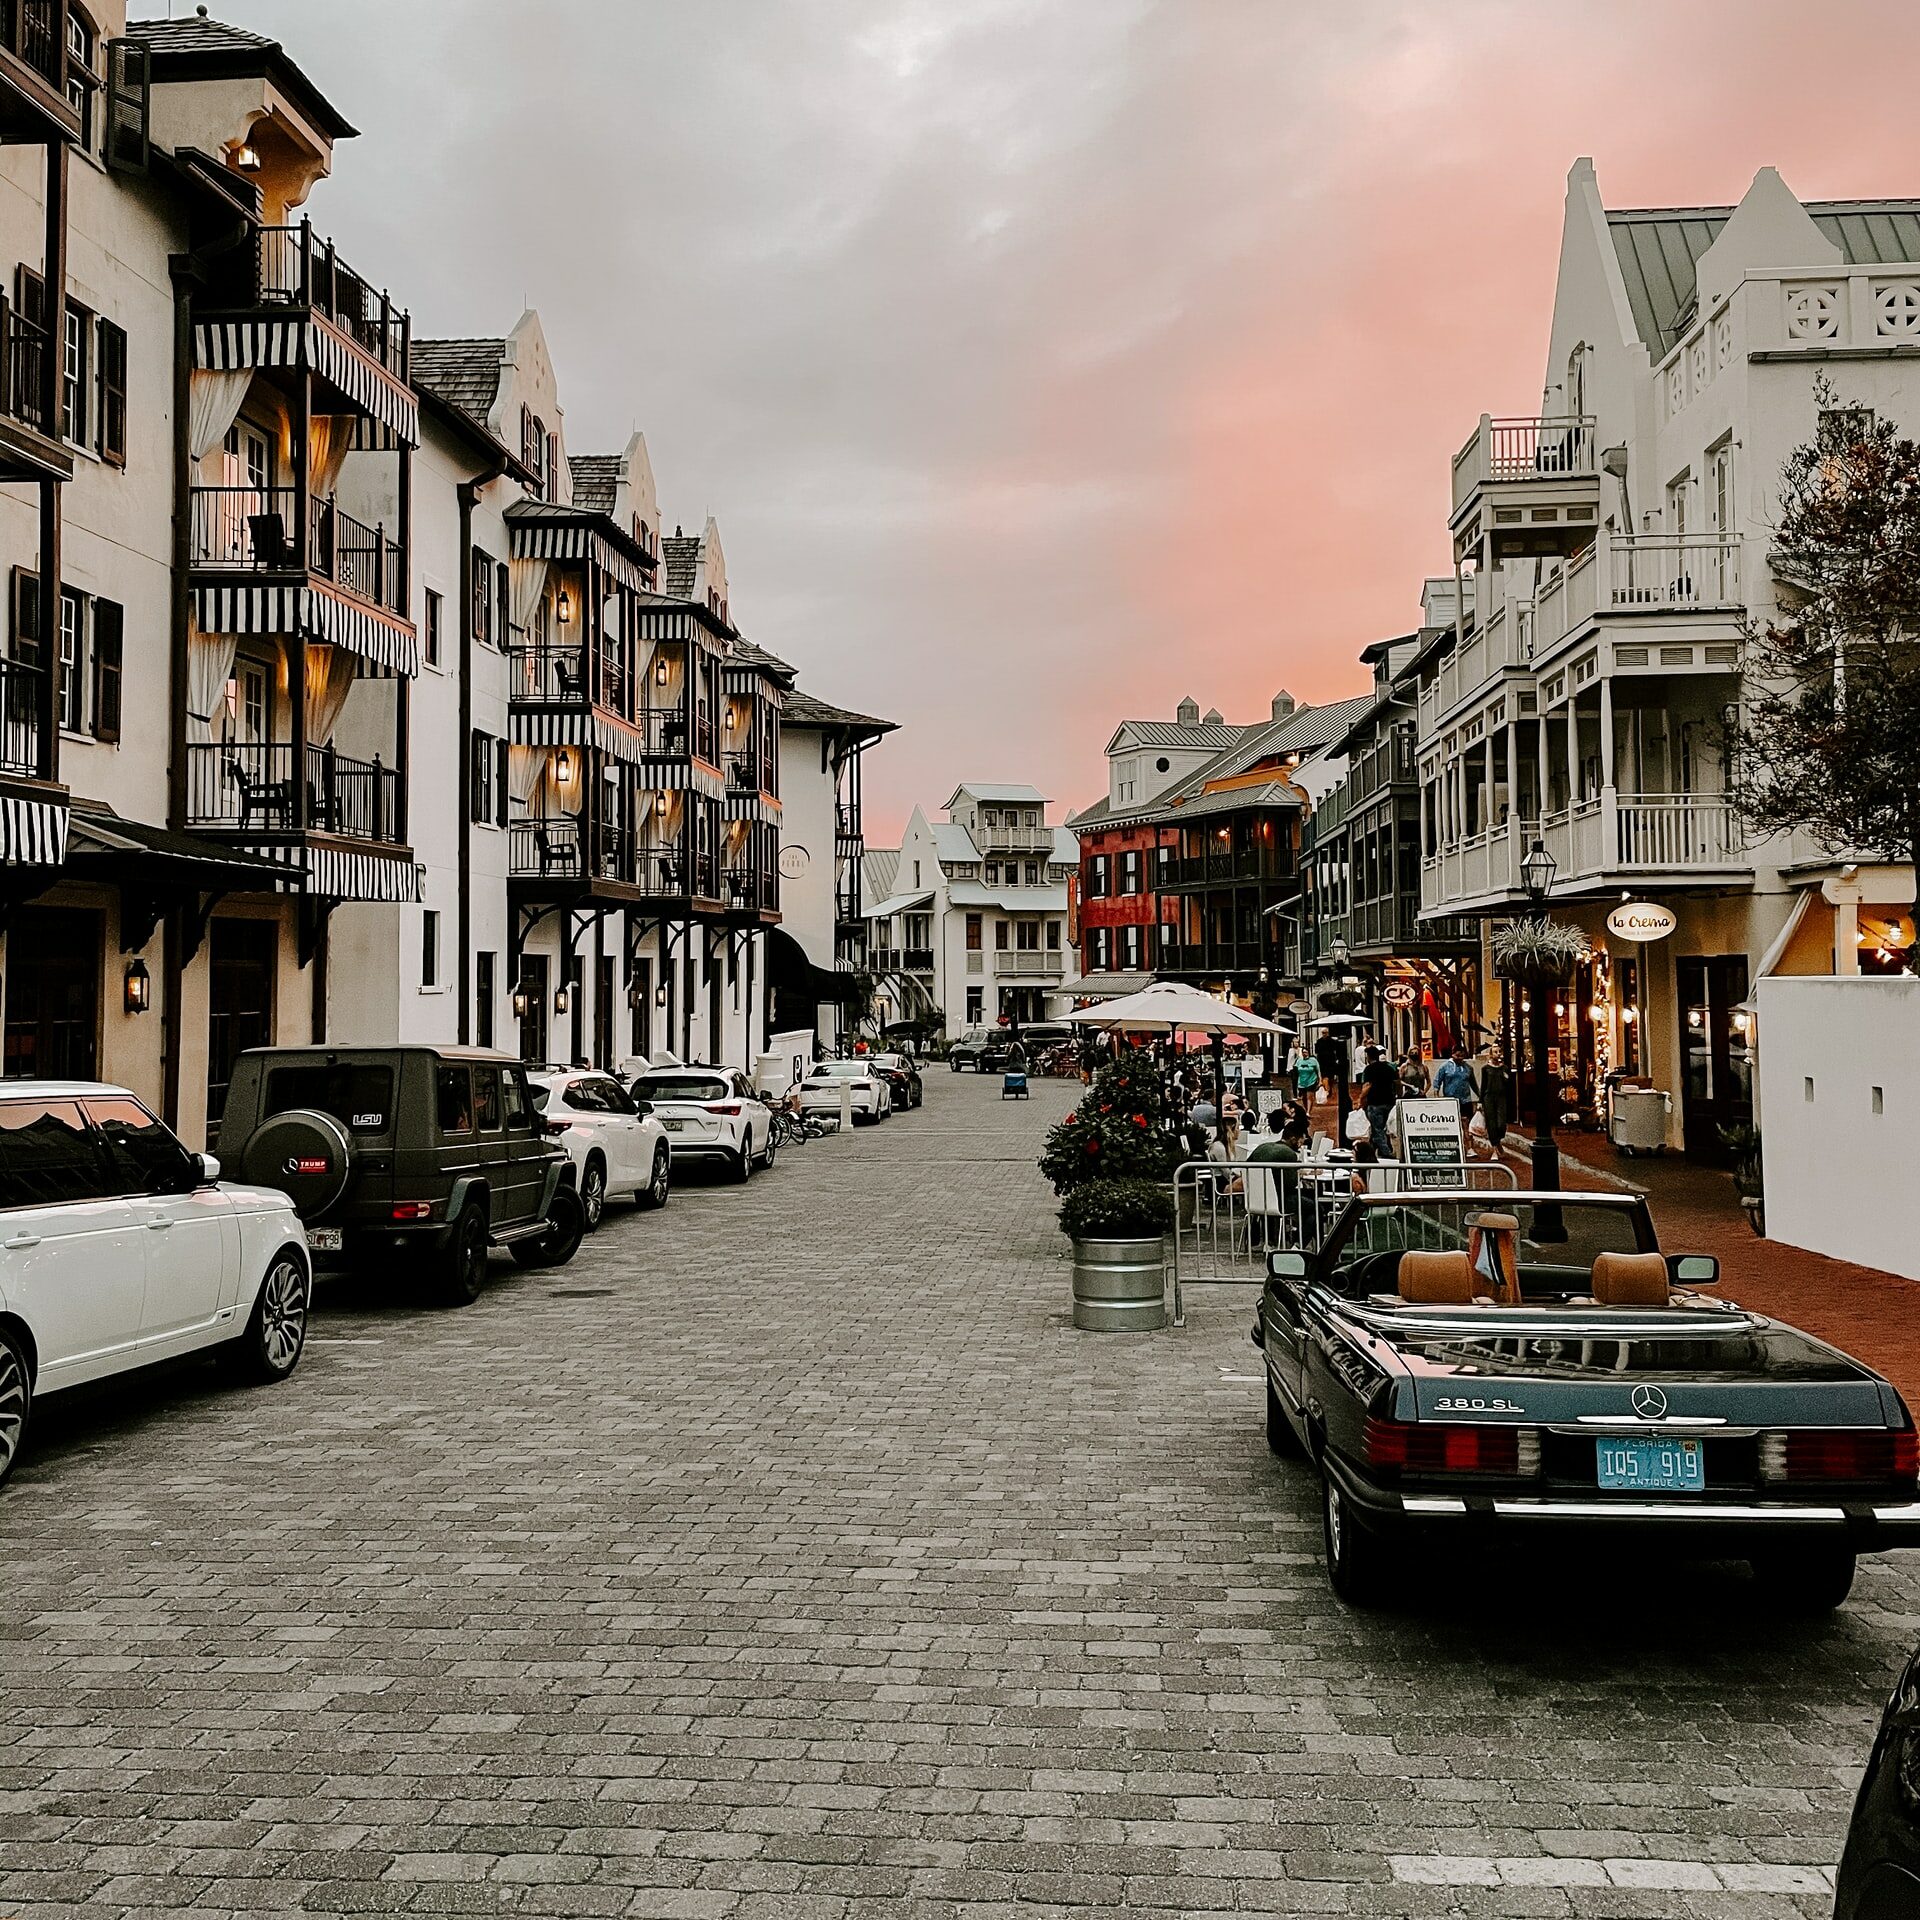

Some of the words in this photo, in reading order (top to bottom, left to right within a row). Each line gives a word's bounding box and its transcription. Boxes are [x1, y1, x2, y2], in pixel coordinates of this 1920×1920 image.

[1613, 916, 1624, 927] la
[1628, 915, 1671, 928] Crema
[1386, 987, 1411, 999] CK
[352, 1113, 382, 1126] LSU
[1405, 1113, 1416, 1123] la
[1420, 1113, 1456, 1123] Crema
[1438, 1397, 1485, 1409] 380
[1492, 1399, 1520, 1410] SL
[1661, 1451, 1698, 1478] 919
[1629, 1478, 1674, 1487] ANTIQUE
